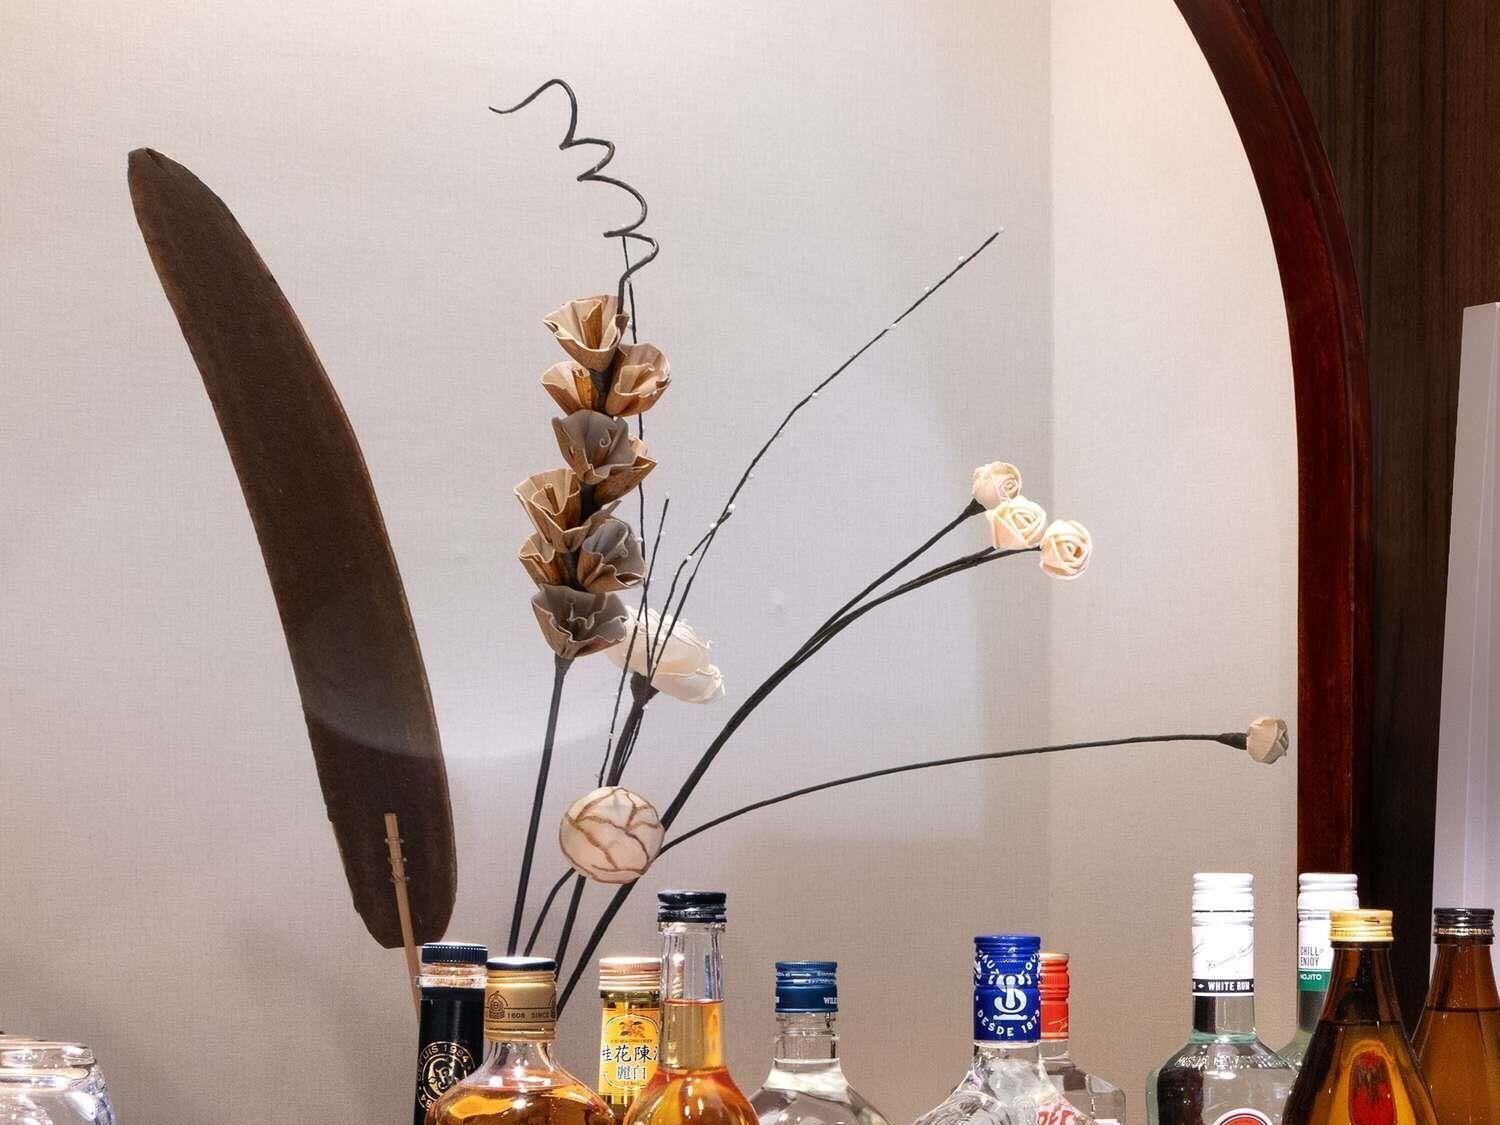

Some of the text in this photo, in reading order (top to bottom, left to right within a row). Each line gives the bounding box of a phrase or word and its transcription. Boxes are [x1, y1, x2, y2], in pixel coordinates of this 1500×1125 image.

[1300, 956, 1320, 967] ENJOY
[1207, 981, 1235, 991] WHITE
[977, 1009, 1014, 1037] DESDE
